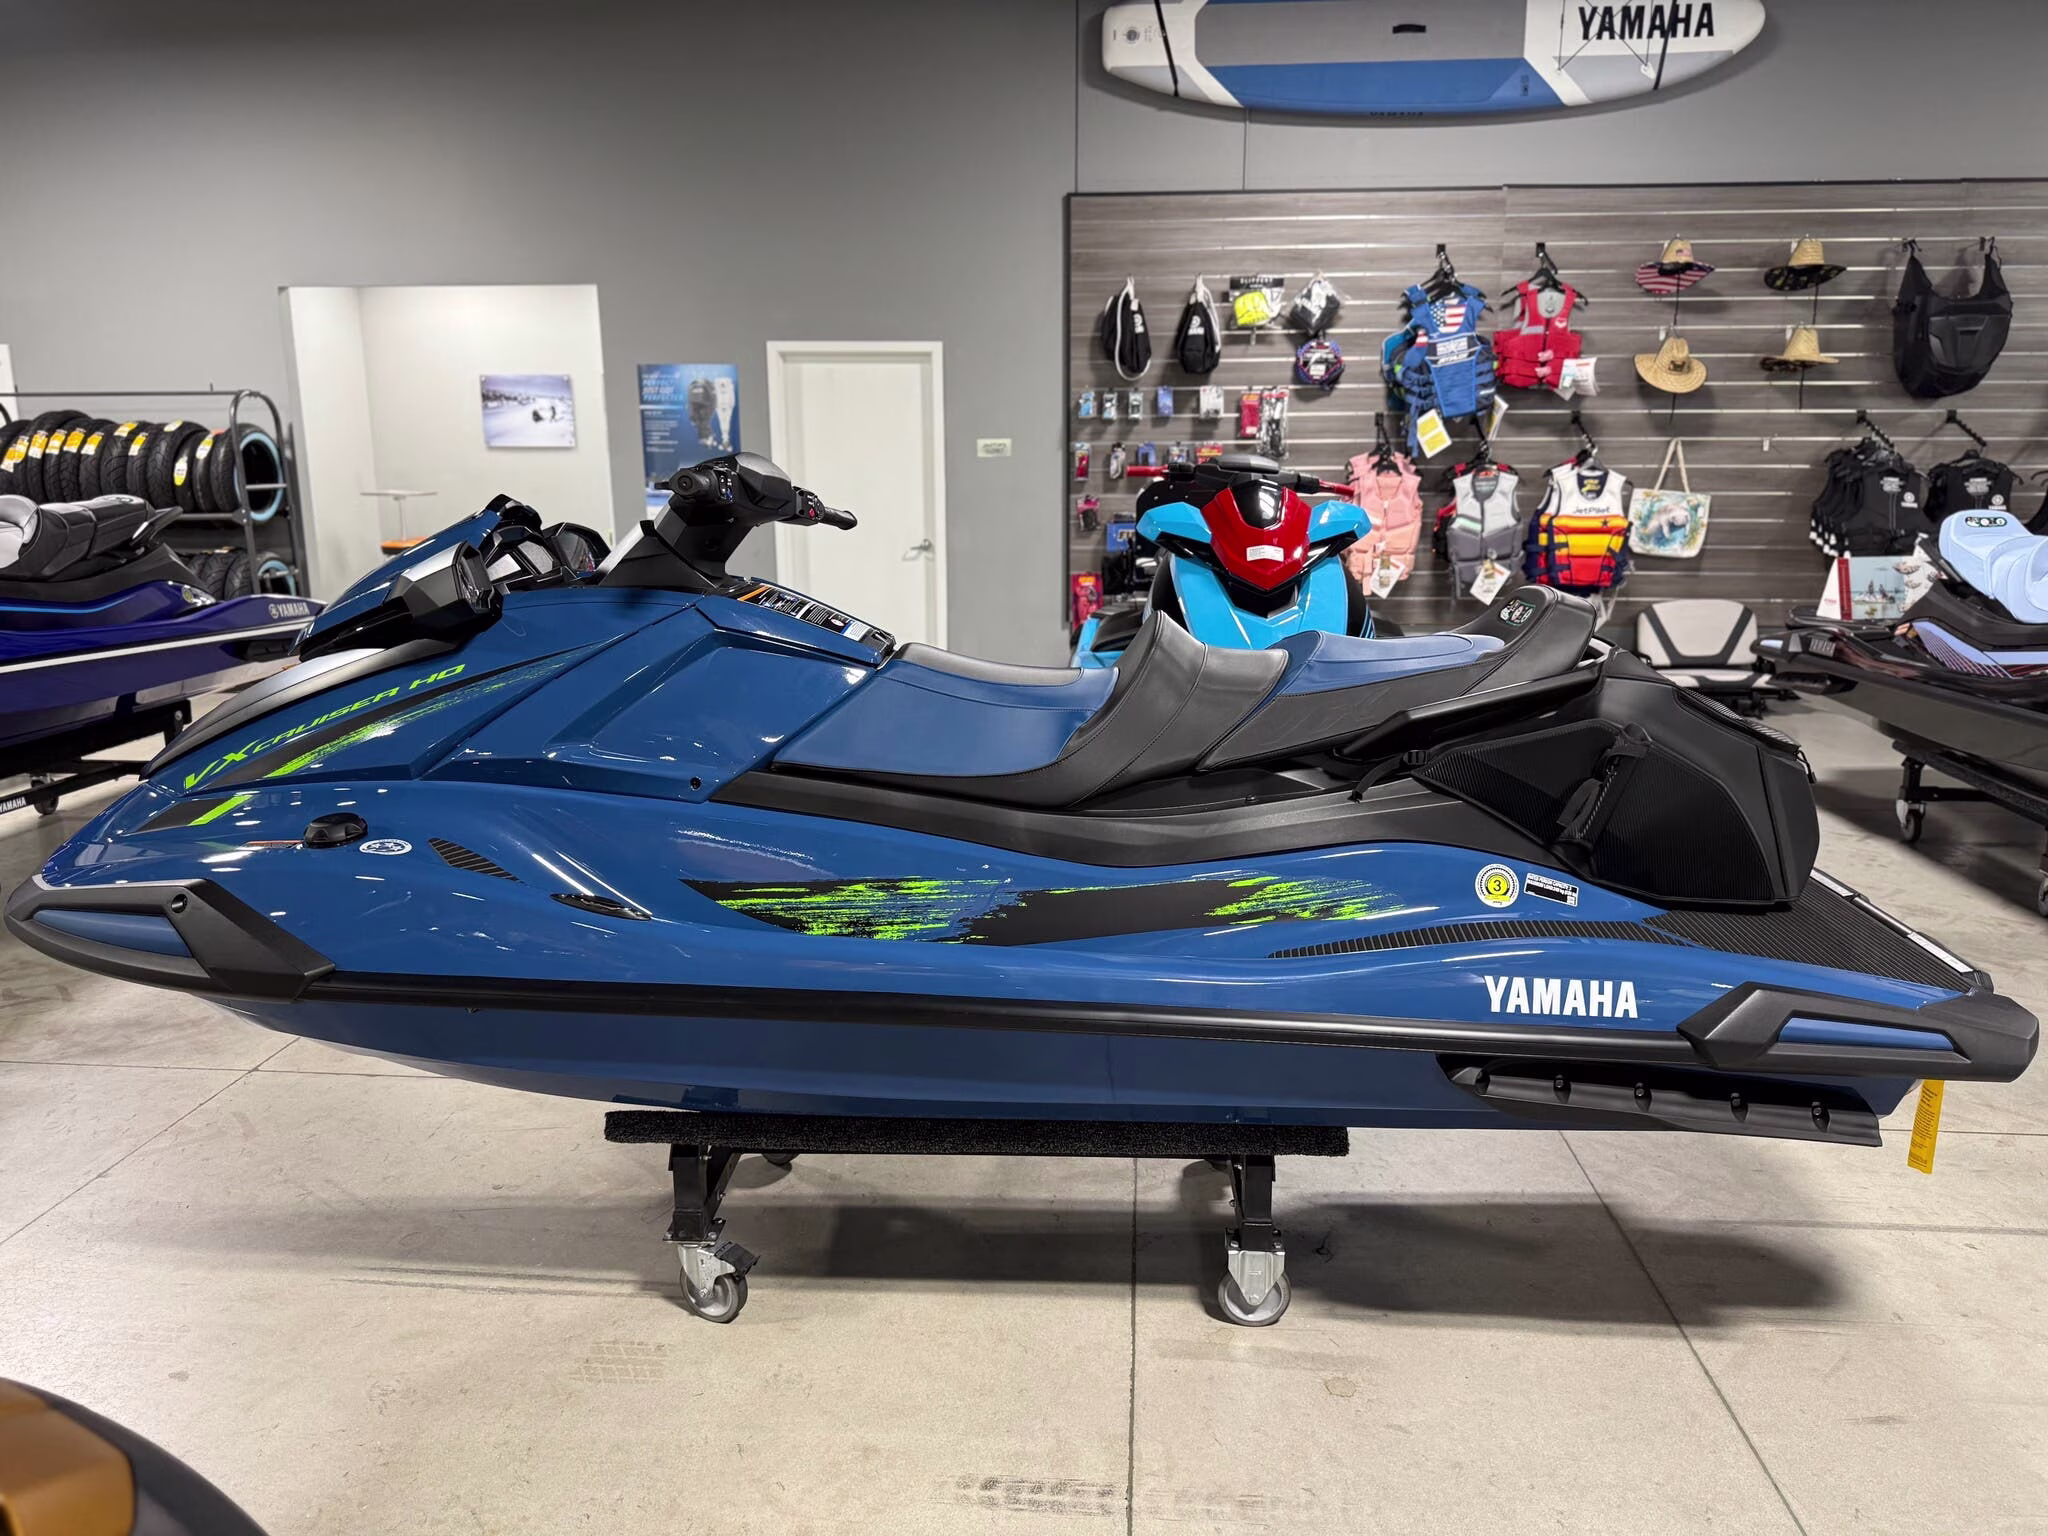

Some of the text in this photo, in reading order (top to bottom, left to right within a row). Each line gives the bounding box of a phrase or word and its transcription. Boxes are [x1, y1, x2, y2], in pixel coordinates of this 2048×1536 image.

[1578, 3, 1715, 40] YAMAHA
[277, 602, 311, 617] YAMAHA
[252, 687, 400, 754] CRUISER
[409, 663, 466, 690] HO
[1493, 879, 1501, 892] 3
[1484, 975, 1638, 1019] YAMAHA
